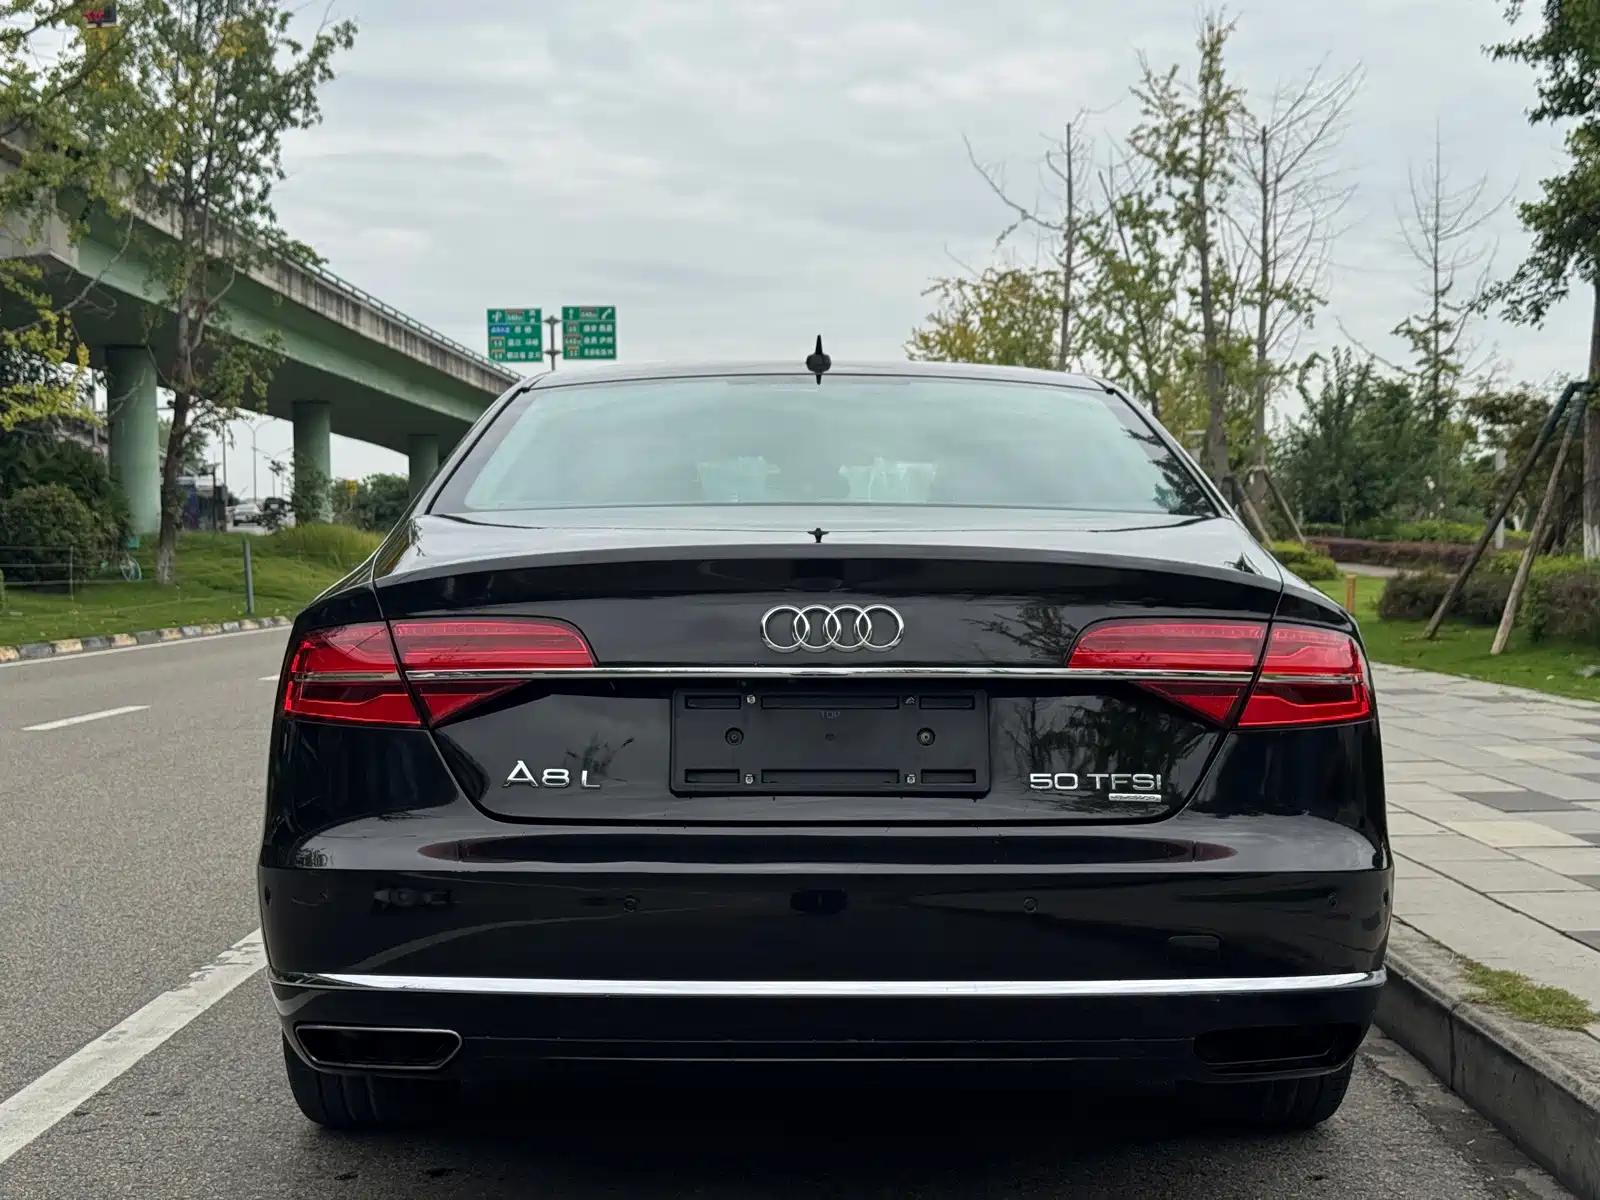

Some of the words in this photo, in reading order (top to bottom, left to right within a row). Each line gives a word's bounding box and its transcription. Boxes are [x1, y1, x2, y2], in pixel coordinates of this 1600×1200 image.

[502, 760, 570, 788] A8
[581, 770, 601, 788] L
[1029, 773, 1078, 790] 50
[1086, 773, 1162, 791] TFSI
